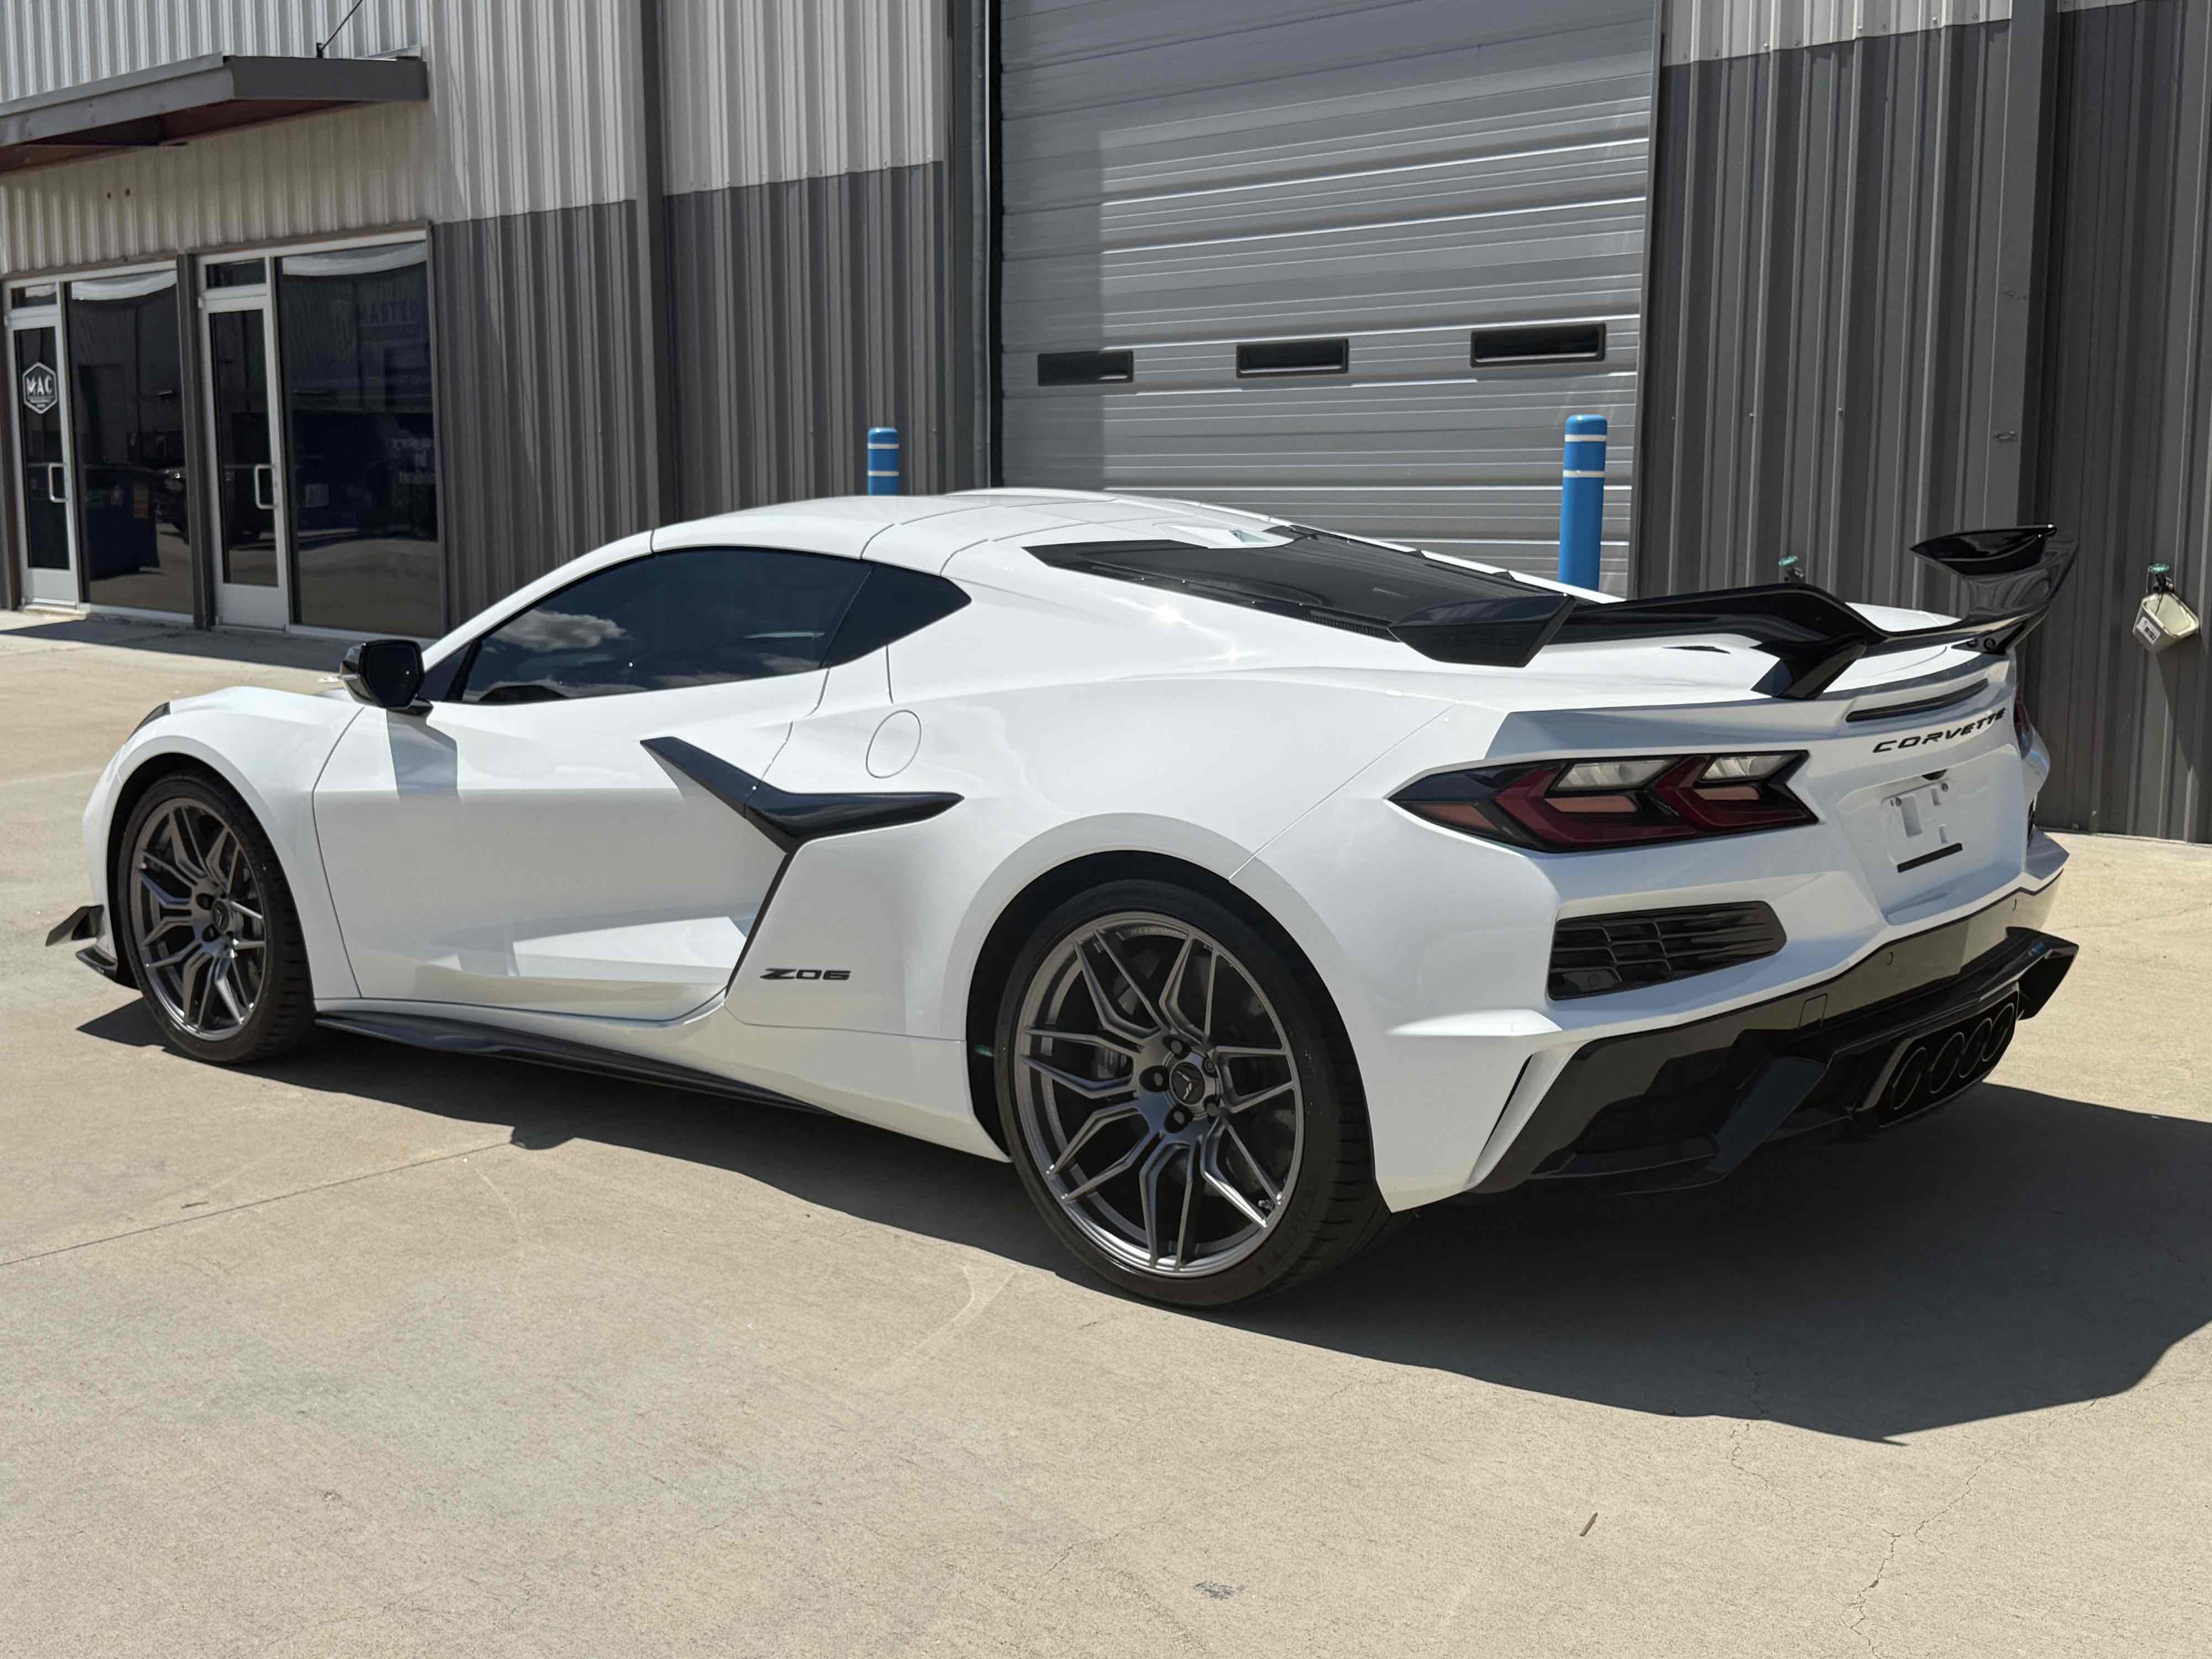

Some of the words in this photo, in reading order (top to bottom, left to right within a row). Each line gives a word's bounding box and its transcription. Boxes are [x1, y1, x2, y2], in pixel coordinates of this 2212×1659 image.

[27, 374, 53, 395] MAC
[1872, 707, 2006, 753] CORVETTE
[760, 968, 851, 980] Z06
